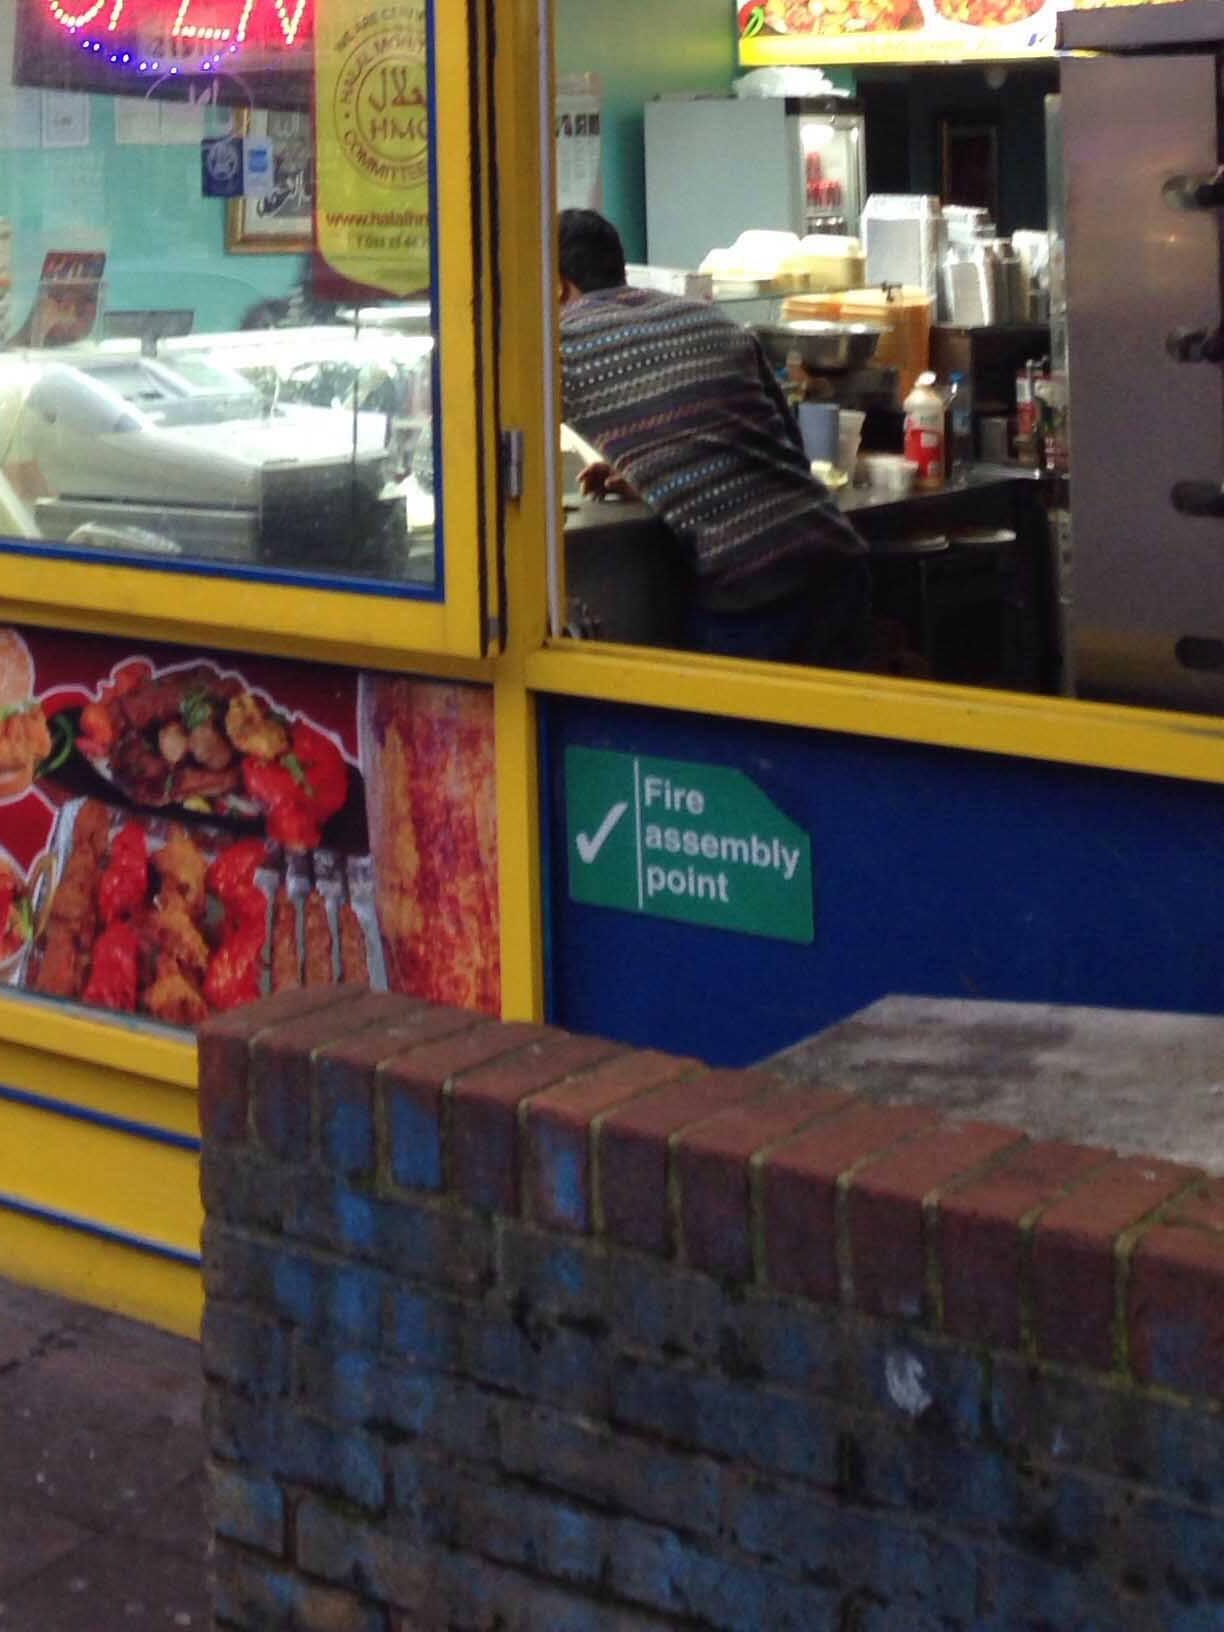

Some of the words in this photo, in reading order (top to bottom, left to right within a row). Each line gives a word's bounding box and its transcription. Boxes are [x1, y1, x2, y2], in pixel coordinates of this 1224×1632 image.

[644, 776, 704, 815] Fire
[645, 824, 800, 881] assembly
[647, 865, 729, 903] point
